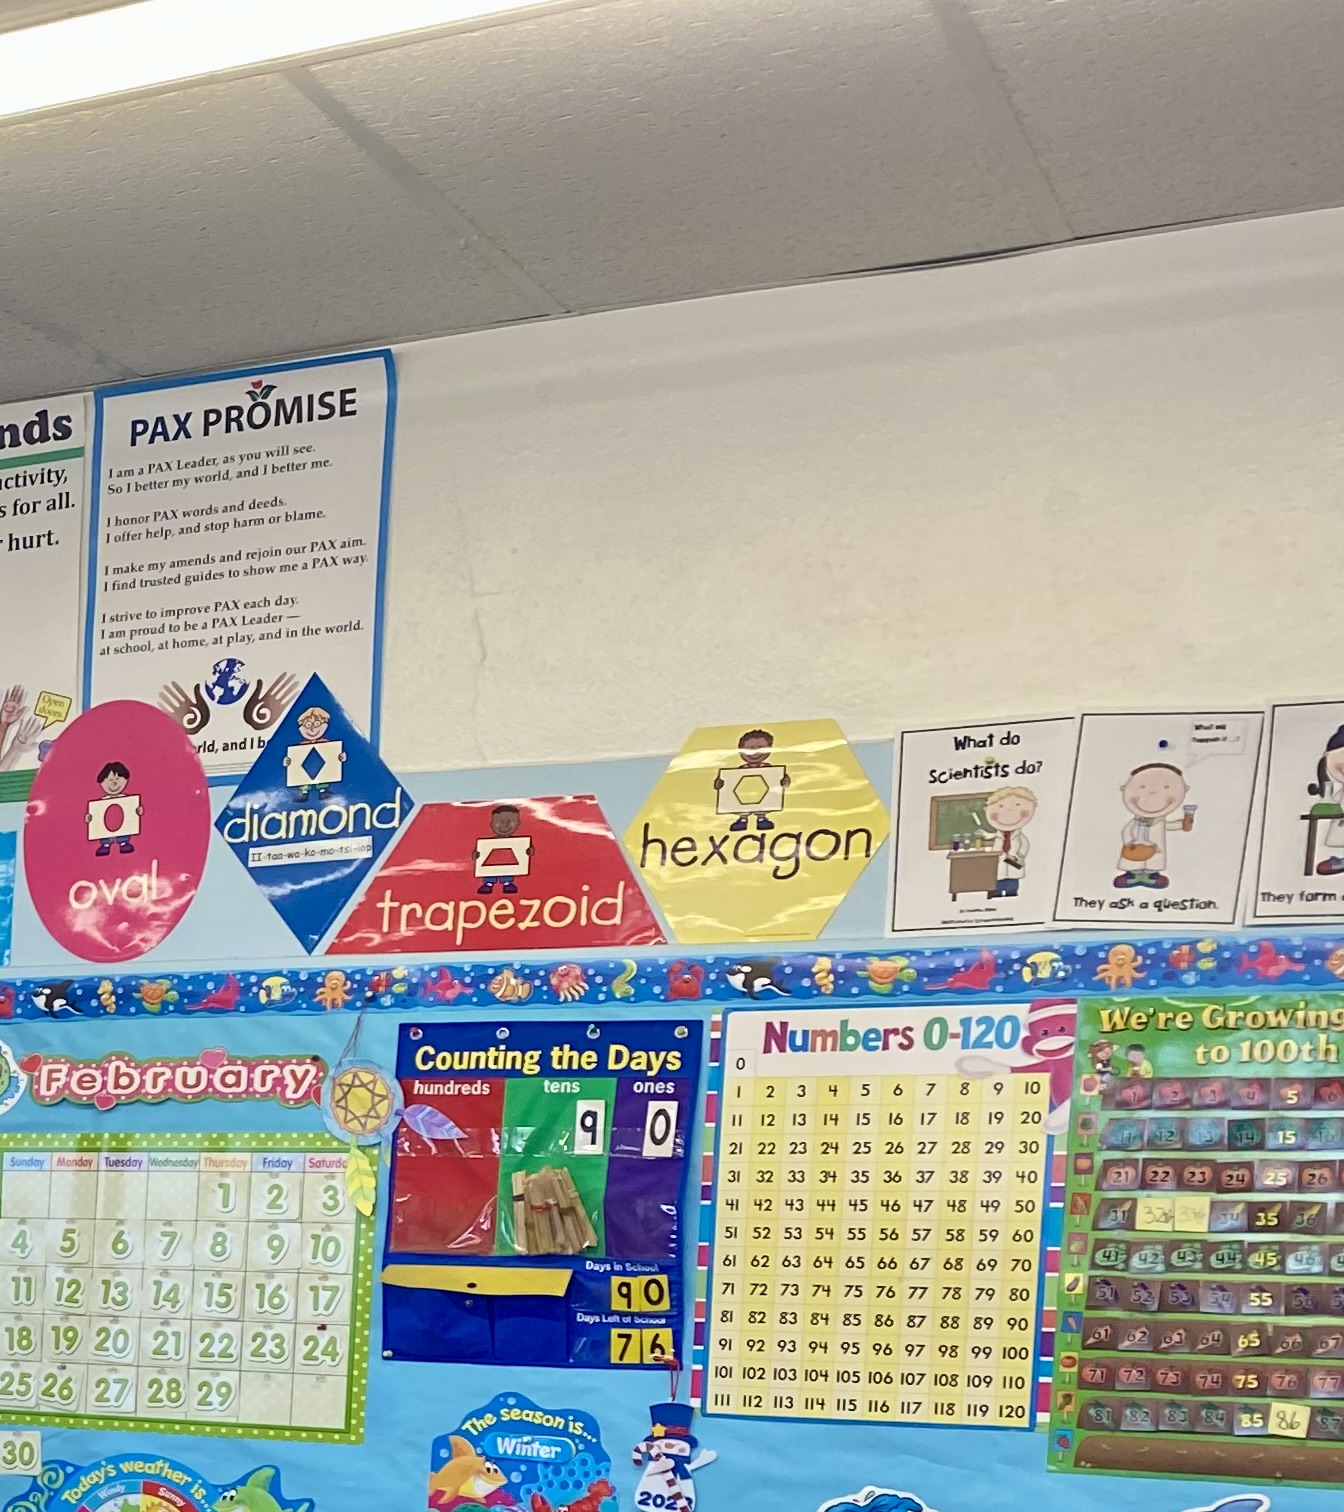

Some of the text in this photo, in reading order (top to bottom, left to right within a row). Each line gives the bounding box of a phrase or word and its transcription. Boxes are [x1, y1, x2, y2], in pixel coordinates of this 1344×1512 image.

[130, 386, 358, 447] PAX PROMISE
[116, 444, 316, 478] am PAX Leader, as you will see.
[12, 497, 41, 516] for
[46, 492, 76, 511] all.
[8, 529, 60, 551] hurt.
[953, 731, 1021, 751] What do
[928, 760, 1043, 784] Scientists do?
[222, 788, 404, 844] diamond
[641, 823, 873, 880] hexagon
[69, 861, 161, 912] oval
[376, 881, 625, 945] trapezoid
[1073, 896, 1219, 912] They ask question.
[1099, 1007, 1193, 1033] We're
[762, 1015, 1020, 1055] Numbers 0-120
[415, 1044, 682, 1076] Counting the Days
[1195, 1038, 1339, 1065] to 100th
[39, 1058, 320, 1098] February
[413, 1080, 675, 1095] hundreds tens ones
[462, 1413, 496, 1436] The
[500, 1408, 565, 1430] season
[497, 1436, 561, 1459] Winter
[63, 1459, 193, 1504] Today's weather
[157, 1487, 186, 1507] Sunny
